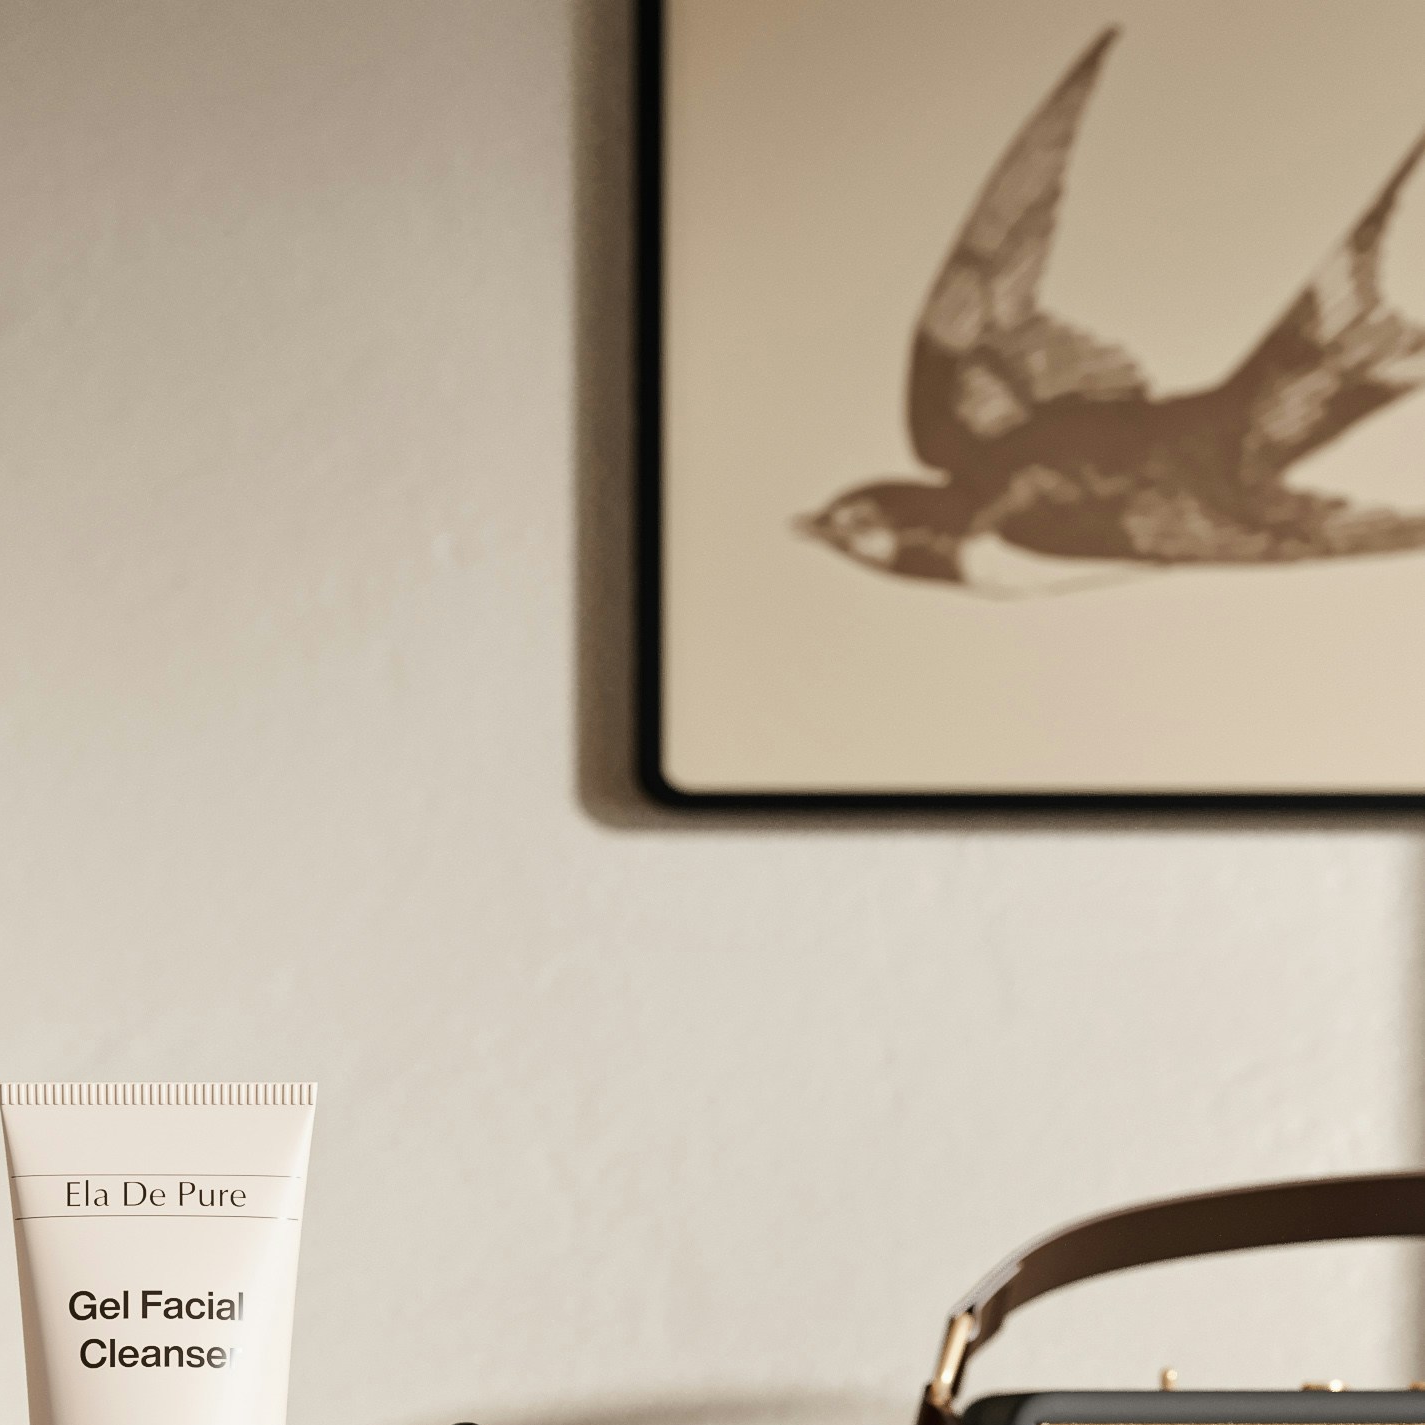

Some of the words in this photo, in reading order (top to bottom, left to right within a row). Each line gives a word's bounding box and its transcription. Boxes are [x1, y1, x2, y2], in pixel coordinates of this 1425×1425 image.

[67, 1180, 109, 1206] Ela
[124, 1182, 165, 1206] De
[180, 1182, 246, 1207] Pure
[69, 1291, 128, 1320] Gel
[142, 1291, 243, 1320] Facial
